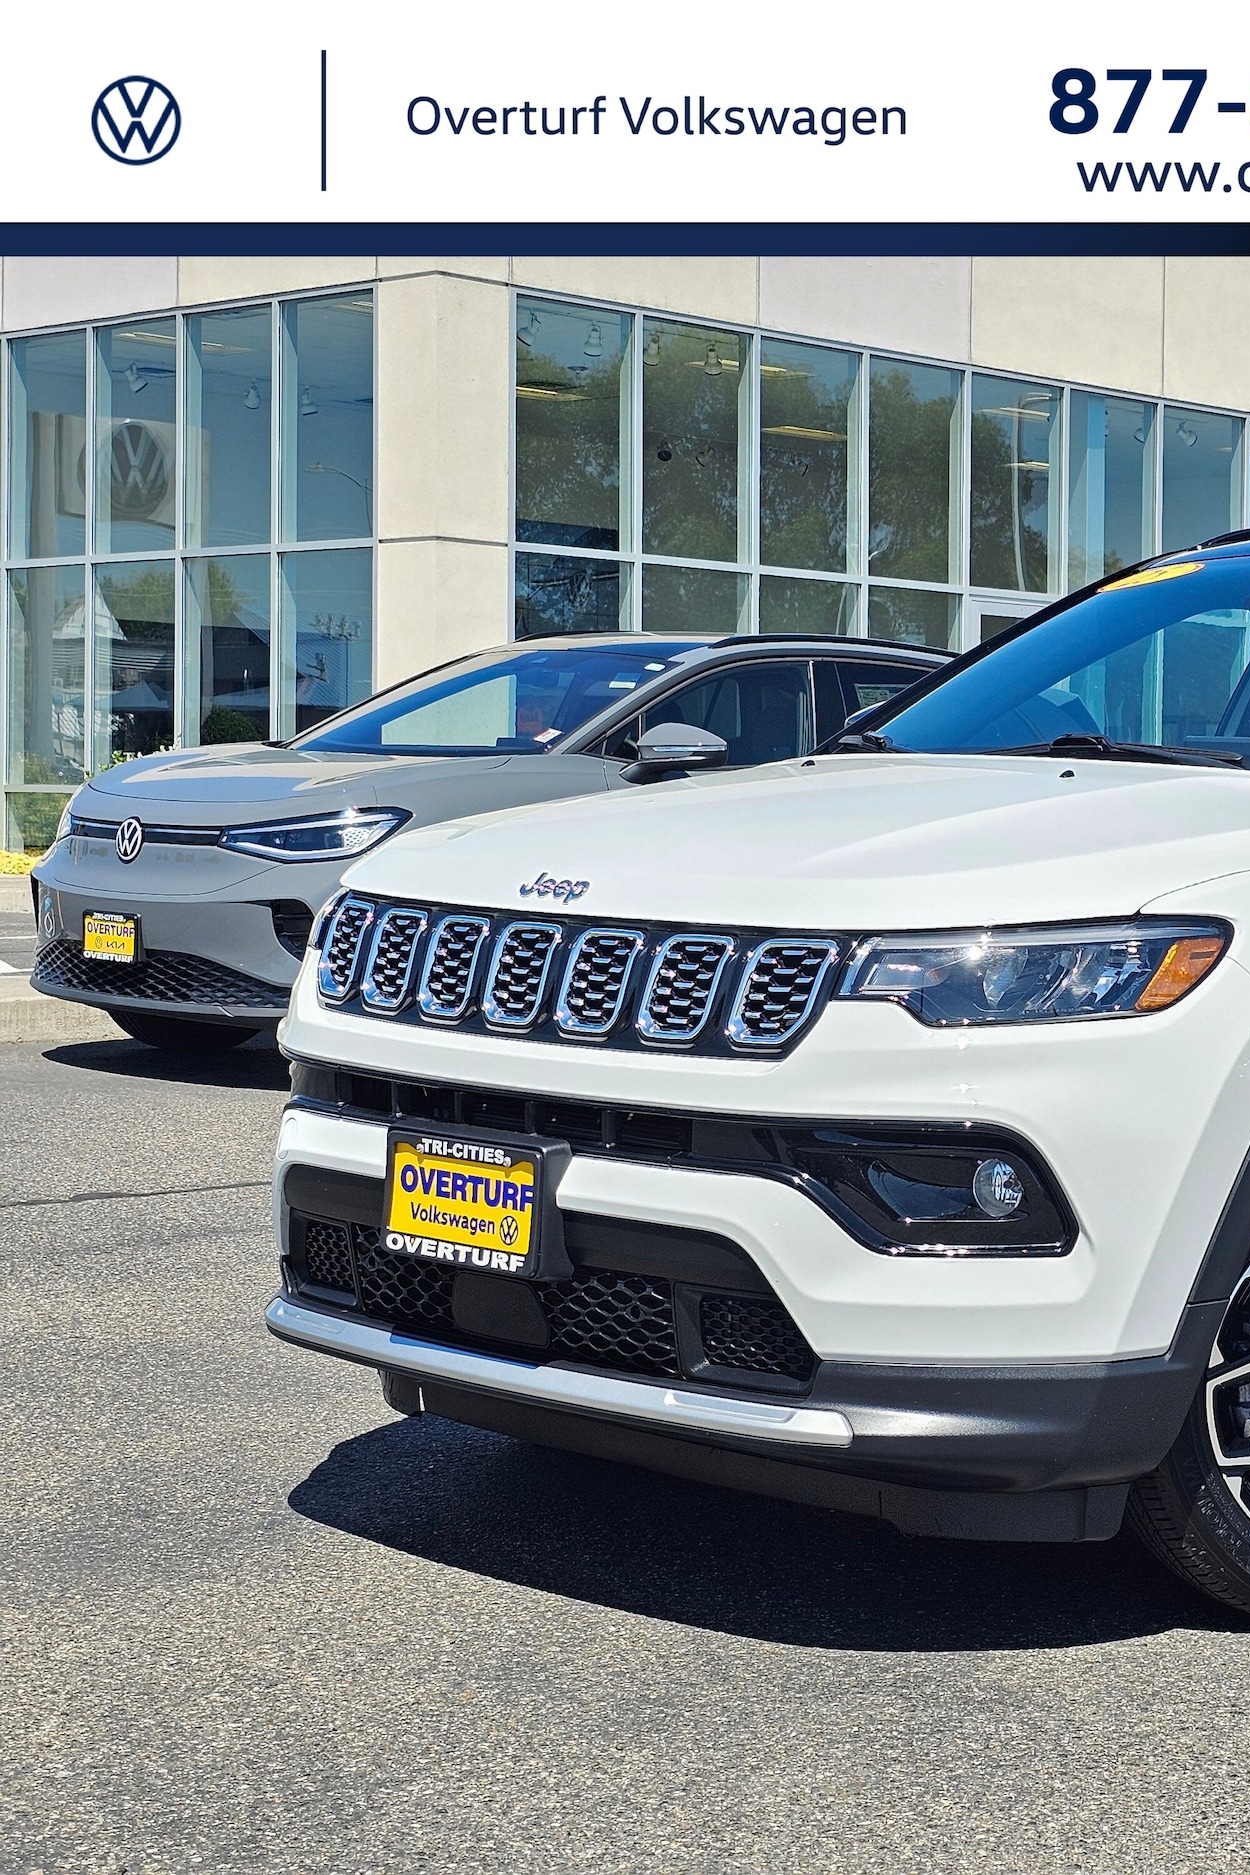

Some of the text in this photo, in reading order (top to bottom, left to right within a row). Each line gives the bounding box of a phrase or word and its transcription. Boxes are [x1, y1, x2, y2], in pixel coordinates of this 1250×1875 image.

[519, 872, 590, 904] Jeep
[87, 921, 135, 938] OVERTURF
[83, 950, 133, 963] OVERTURF
[421, 1138, 506, 1164] TRI-CITIES
[400, 1164, 535, 1212] OVERTURF
[410, 1201, 496, 1236] Volkswagen
[385, 1232, 526, 1272] OVERTURF
